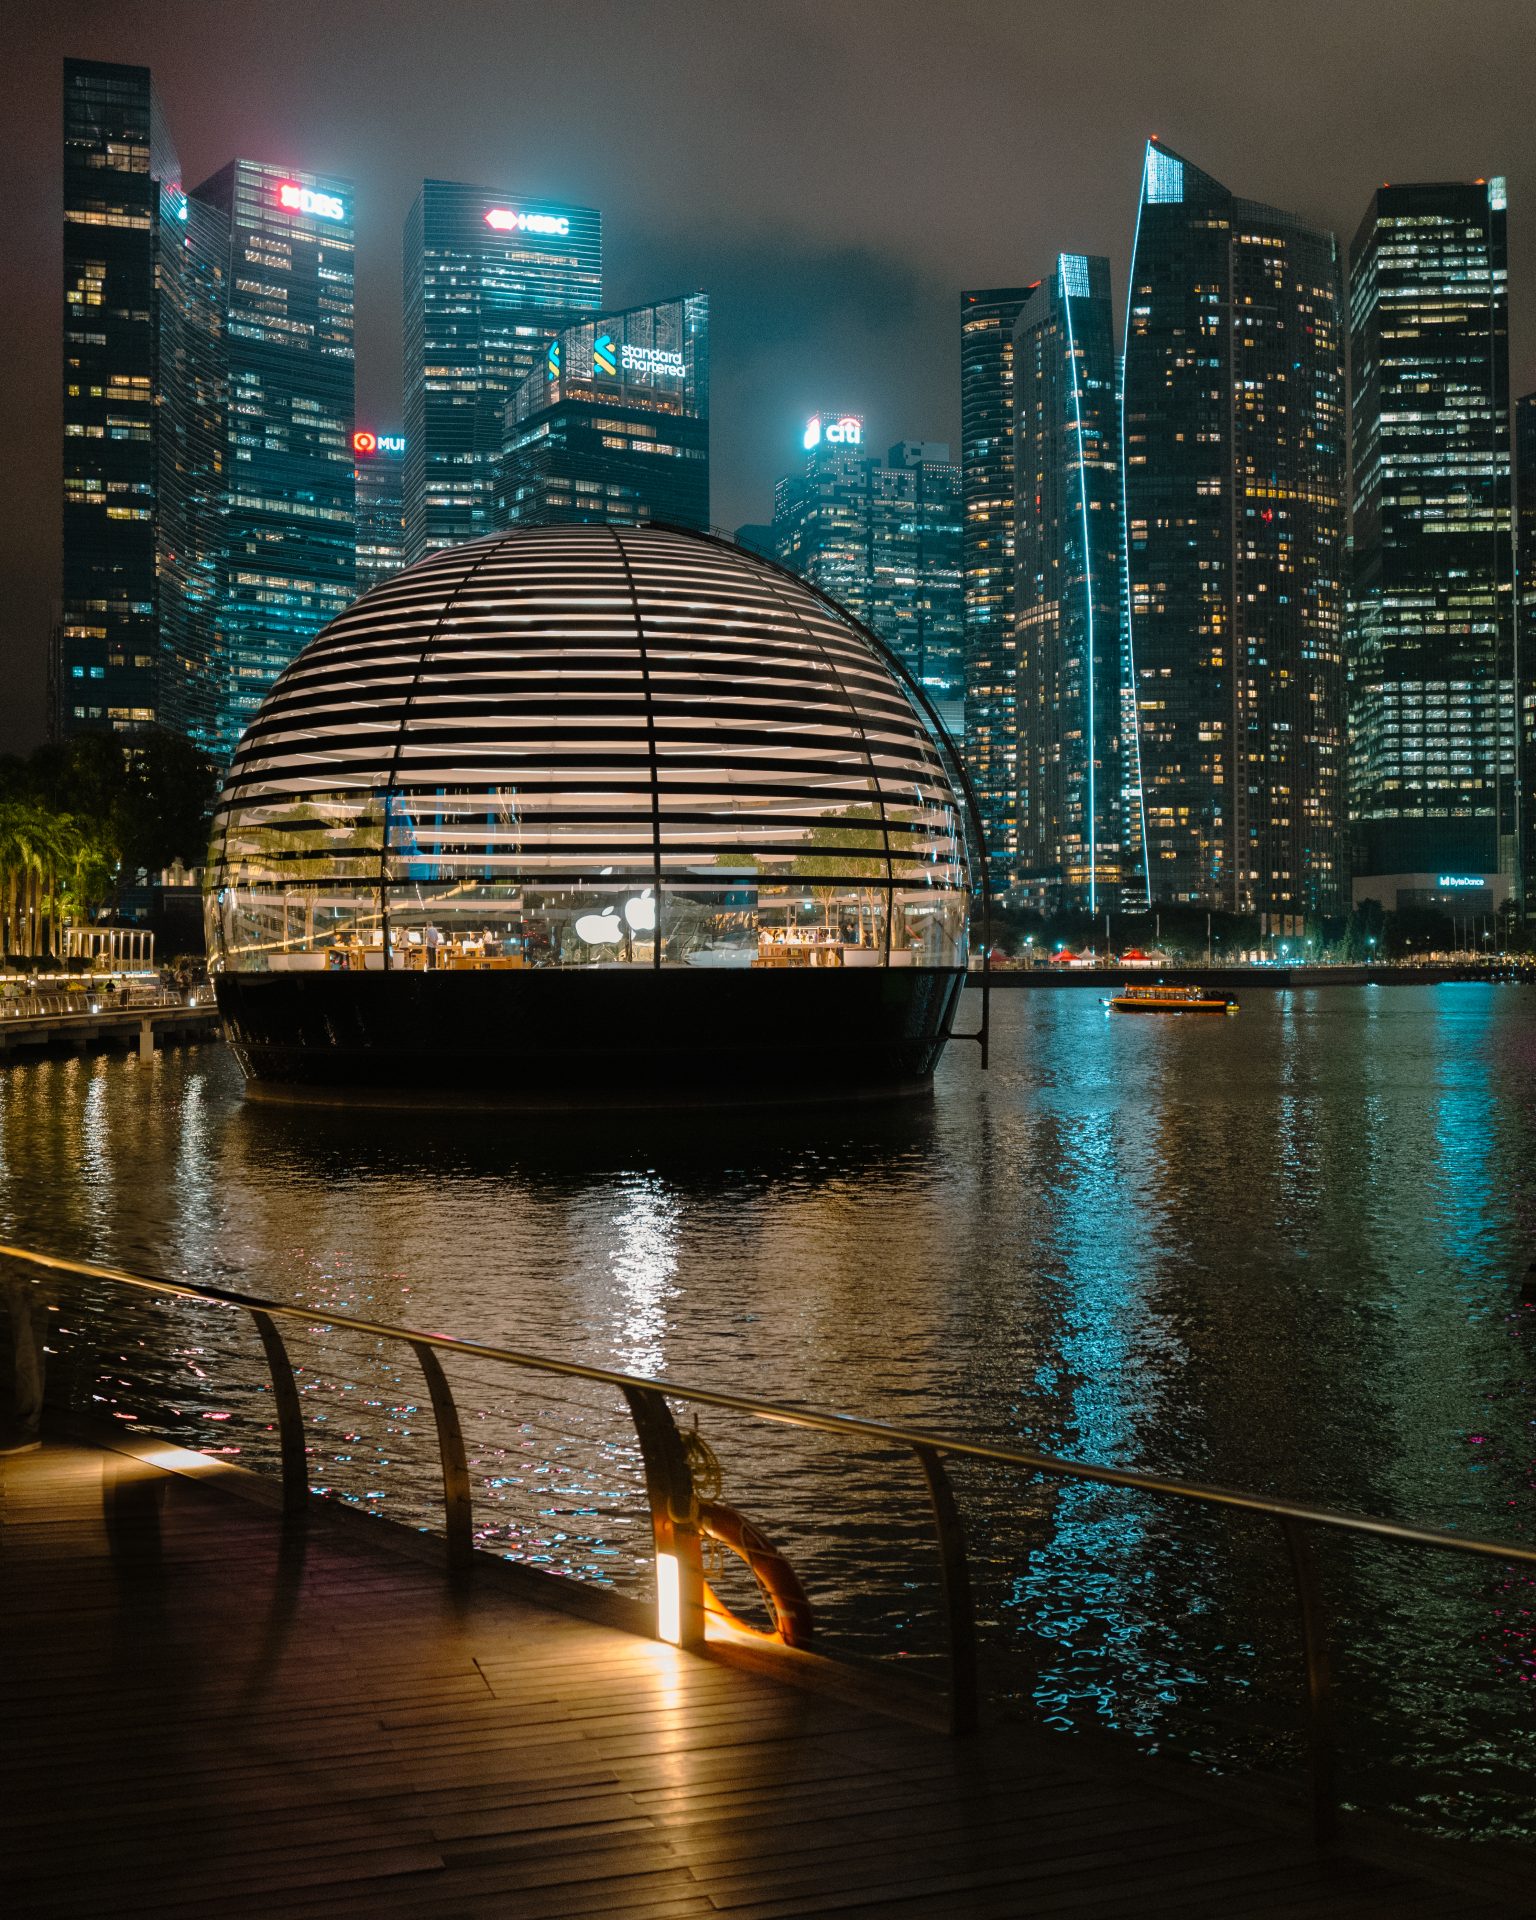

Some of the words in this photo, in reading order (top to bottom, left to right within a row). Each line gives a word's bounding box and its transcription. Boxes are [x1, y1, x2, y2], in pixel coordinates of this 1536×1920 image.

[621, 344, 682, 365] standard
[621, 357, 686, 377] chartered
[825, 420, 861, 444] citi
[1450, 877, 1484, 887] ByteDance
